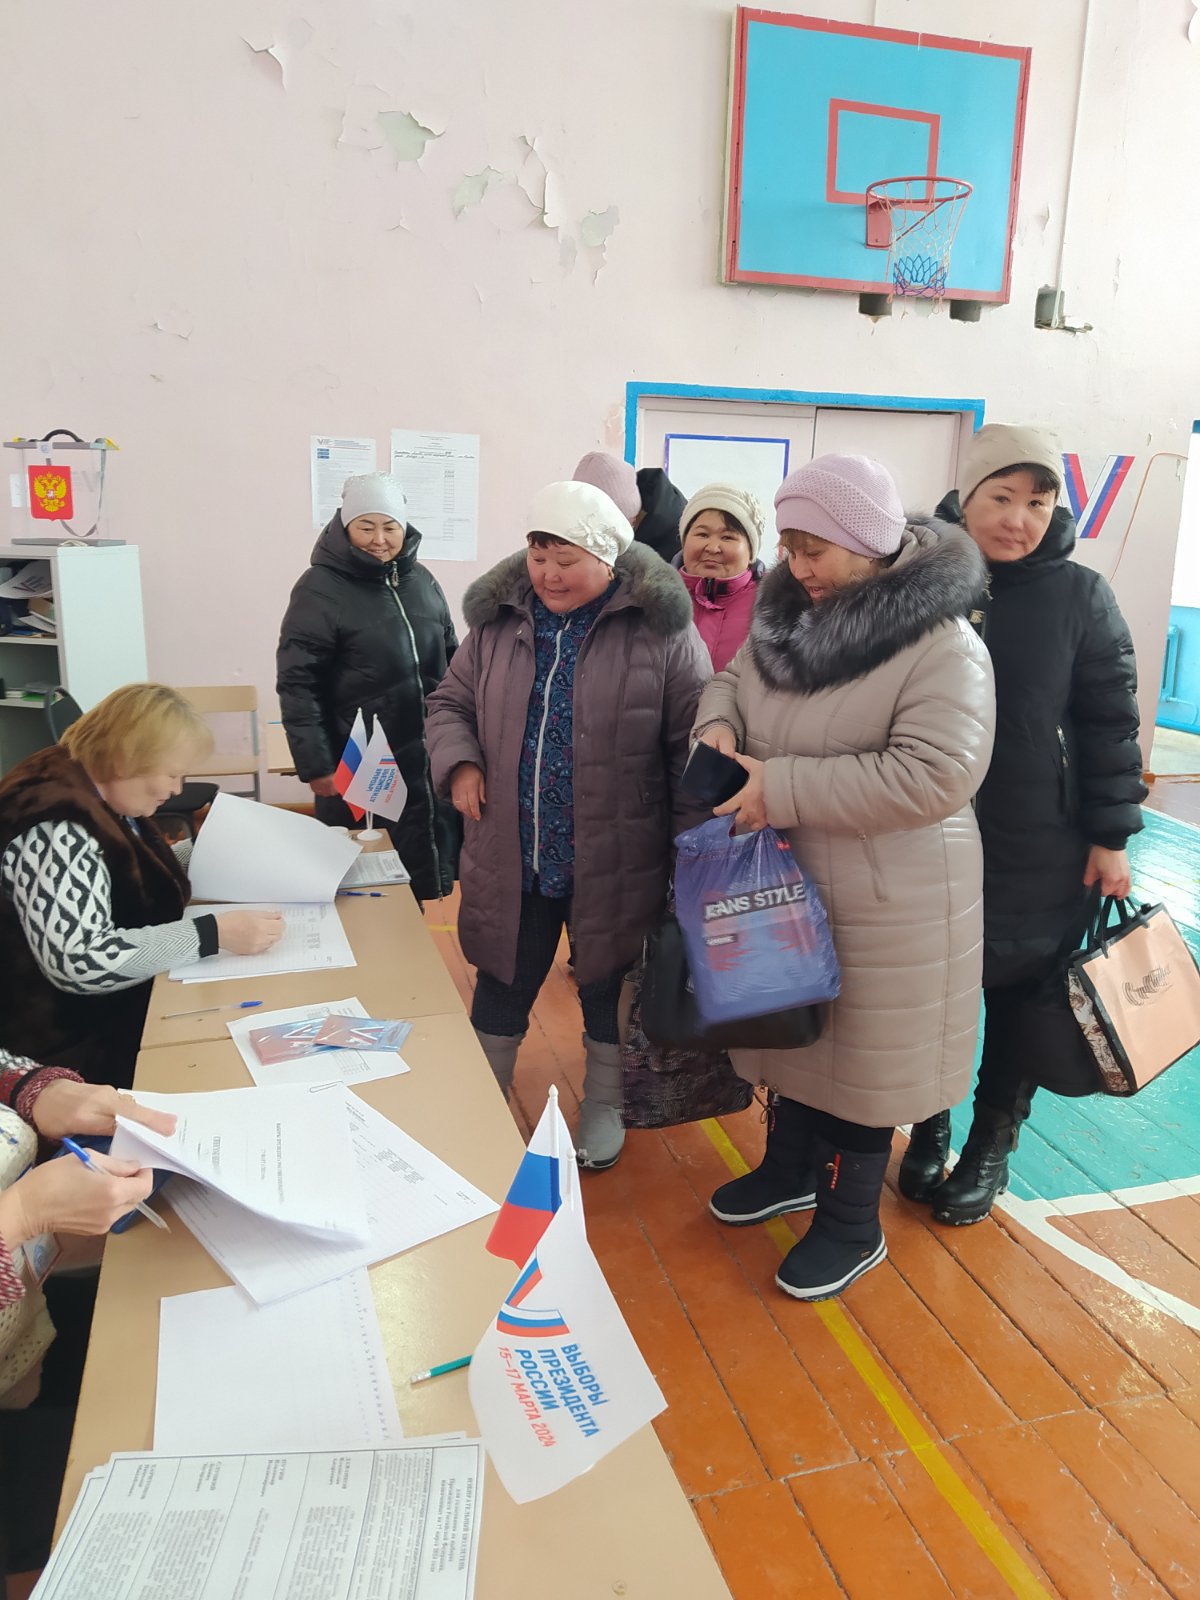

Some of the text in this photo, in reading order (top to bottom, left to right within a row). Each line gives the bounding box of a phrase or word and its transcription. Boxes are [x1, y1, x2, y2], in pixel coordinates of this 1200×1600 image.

[754, 883, 806, 907] STYLE
[514, 1348, 561, 1411] РОССИИ
[537, 1348, 600, 1438] ПРЕЗИДЕНТА
[561, 1343, 610, 1406] ВЫБОРЫ
[510, 1382, 542, 1421] МАРТА
[531, 1422, 557, 1448] 2024
